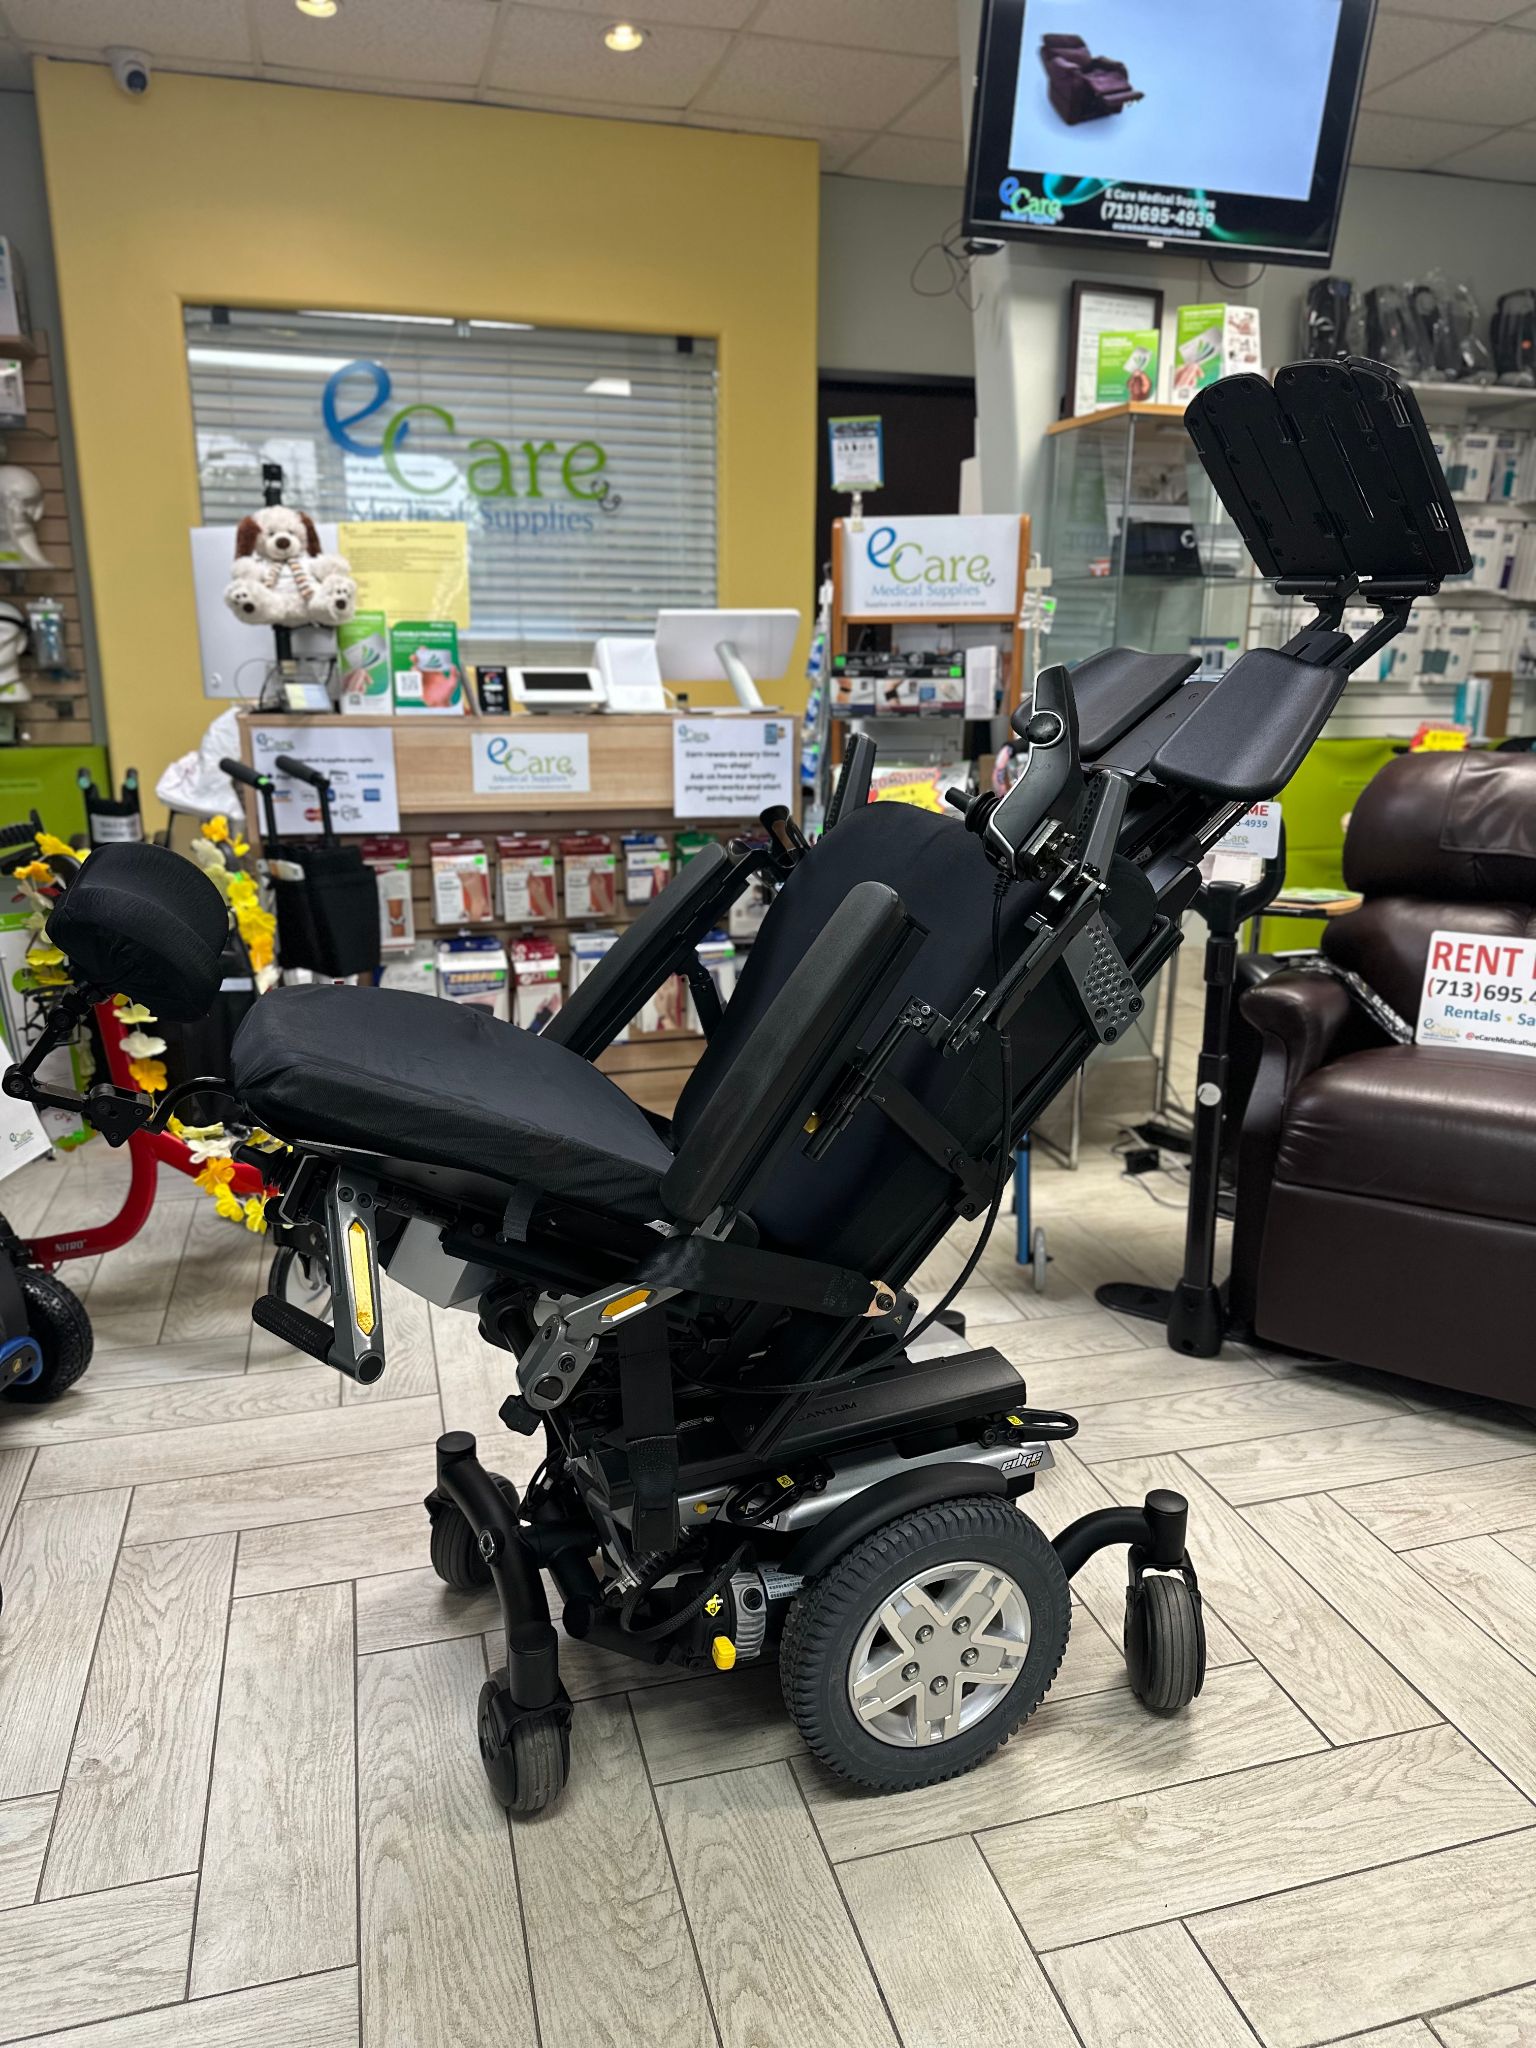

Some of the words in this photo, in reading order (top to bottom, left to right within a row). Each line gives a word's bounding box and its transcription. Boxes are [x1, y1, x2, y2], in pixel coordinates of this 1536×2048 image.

[1101, 201, 1216, 229] (713)695-4939
[481, 501, 595, 534] Supplies
[871, 583, 922, 597] Medical
[926, 583, 981, 599] Supplies
[739, 751, 760, 760] every
[750, 772, 776, 781] loyalty
[873, 771, 935, 789] ROMOTION
[685, 785, 719, 793] program
[1222, 832, 1249, 844] Care
[1432, 941, 1524, 978] RENT
[1444, 1004, 1501, 1022] Rentals
[1001, 1451, 1043, 1471] edge
